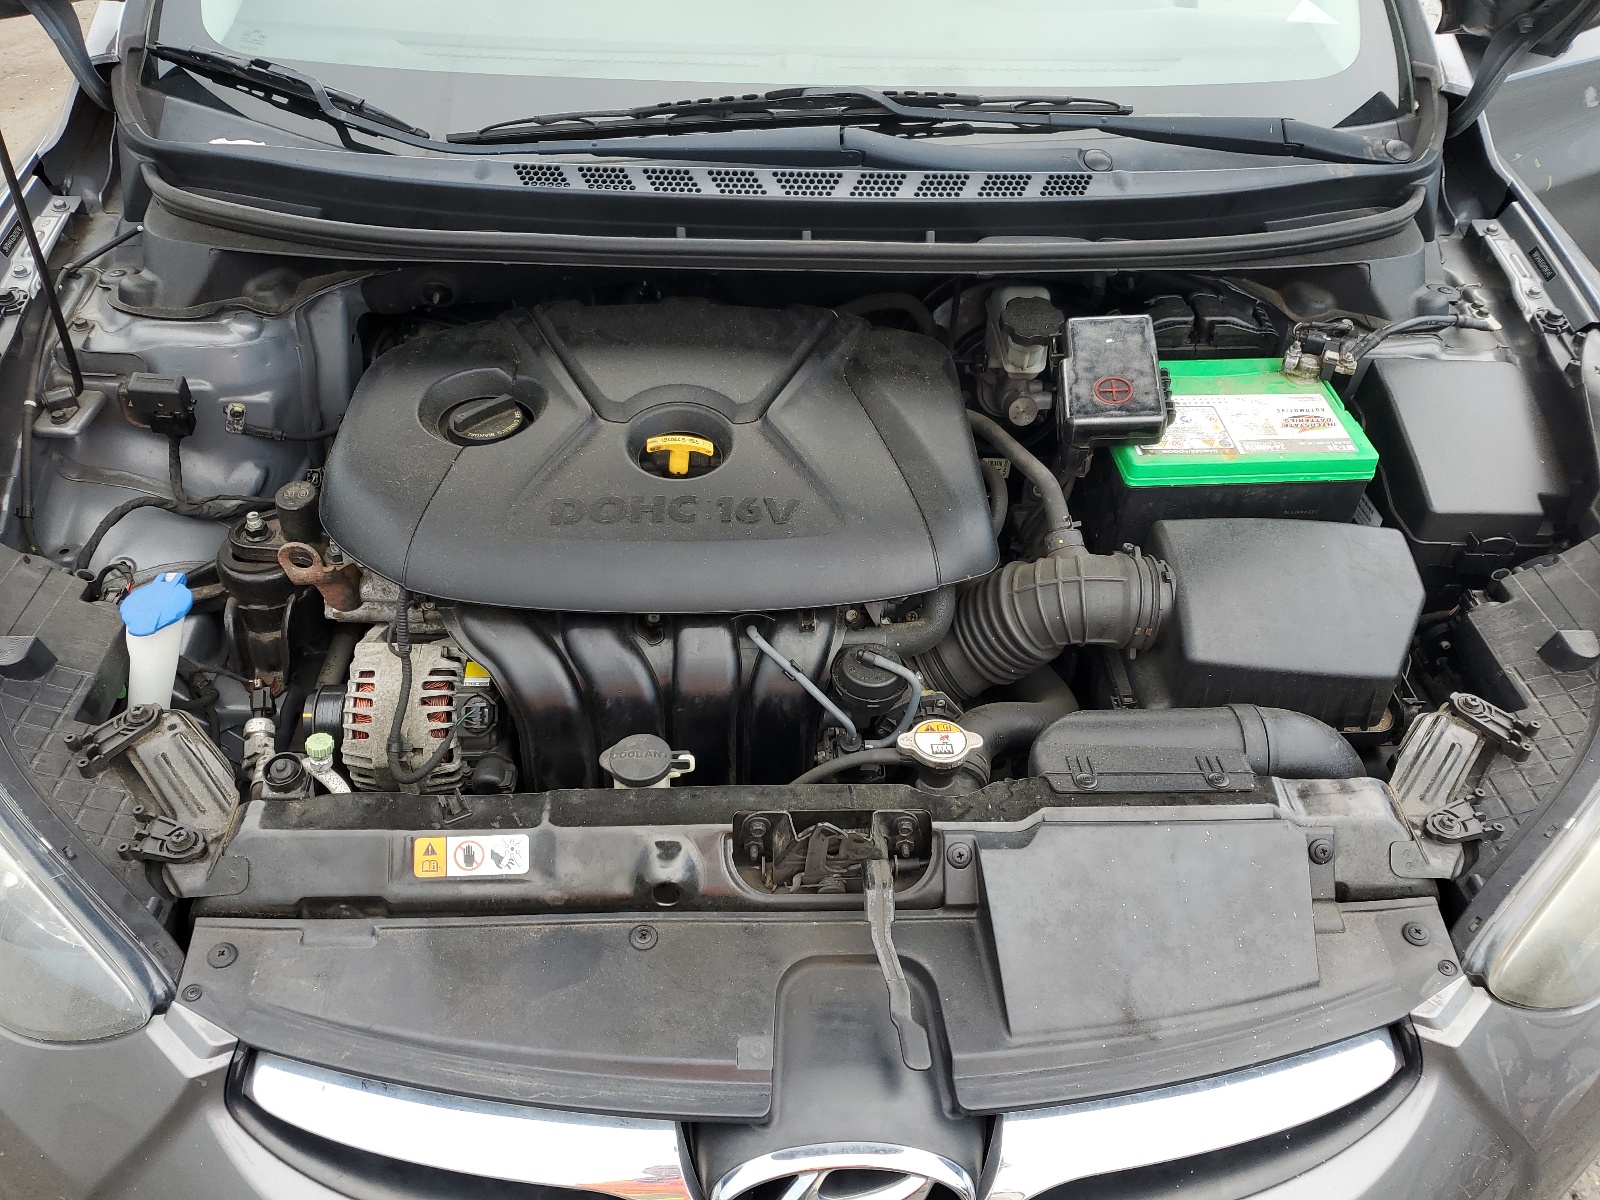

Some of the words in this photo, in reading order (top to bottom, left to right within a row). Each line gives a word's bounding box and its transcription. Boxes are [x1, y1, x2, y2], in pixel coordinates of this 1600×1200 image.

[549, 495, 698, 526] DOHC
[715, 496, 801, 525] 16V
[611, 749, 667, 759] COOLANT
